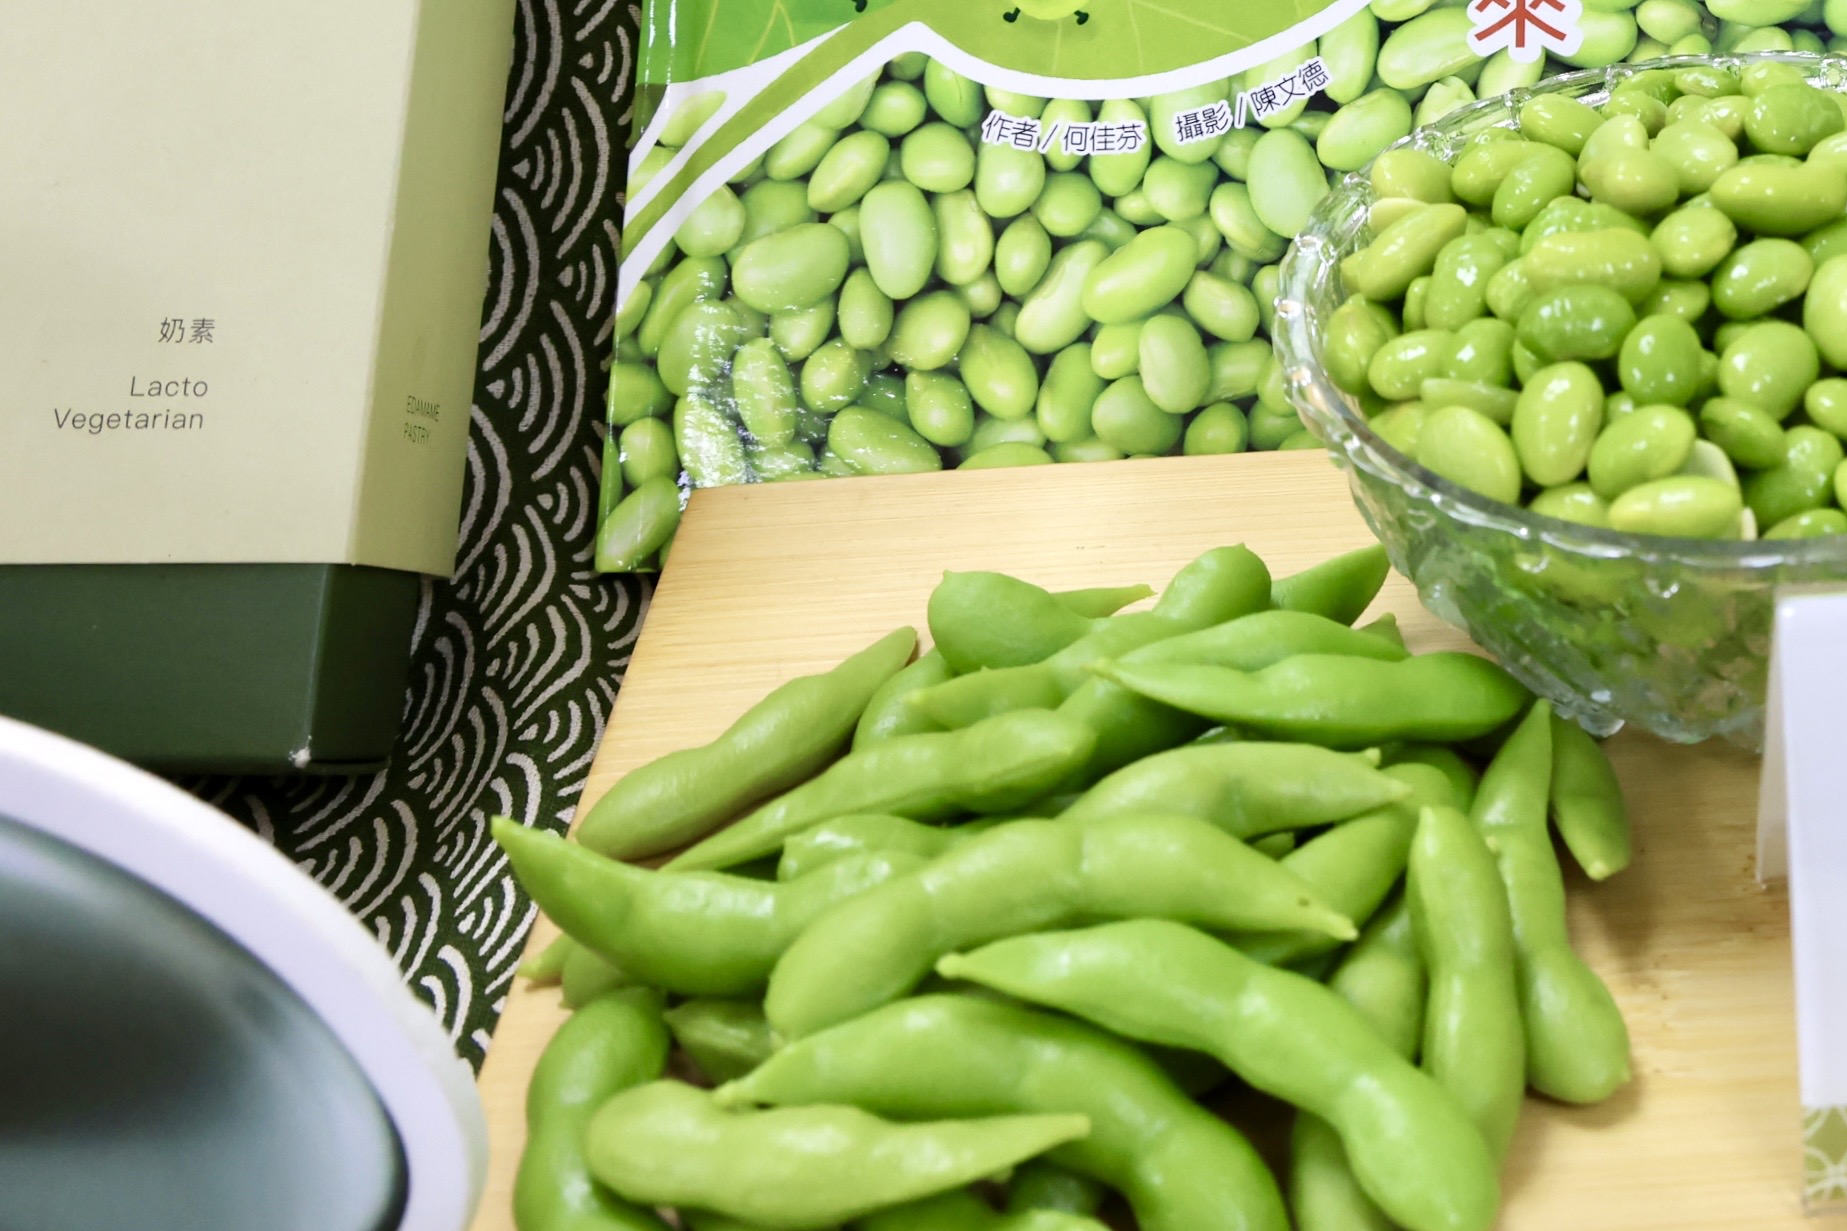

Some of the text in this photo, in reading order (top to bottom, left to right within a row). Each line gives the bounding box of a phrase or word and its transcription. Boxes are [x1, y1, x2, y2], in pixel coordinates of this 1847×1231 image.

[158, 317, 216, 345] 奶素
[130, 376, 209, 398] Lacto
[53, 408, 205, 435] Vegetarian
[406, 395, 441, 423] EDAMAME
